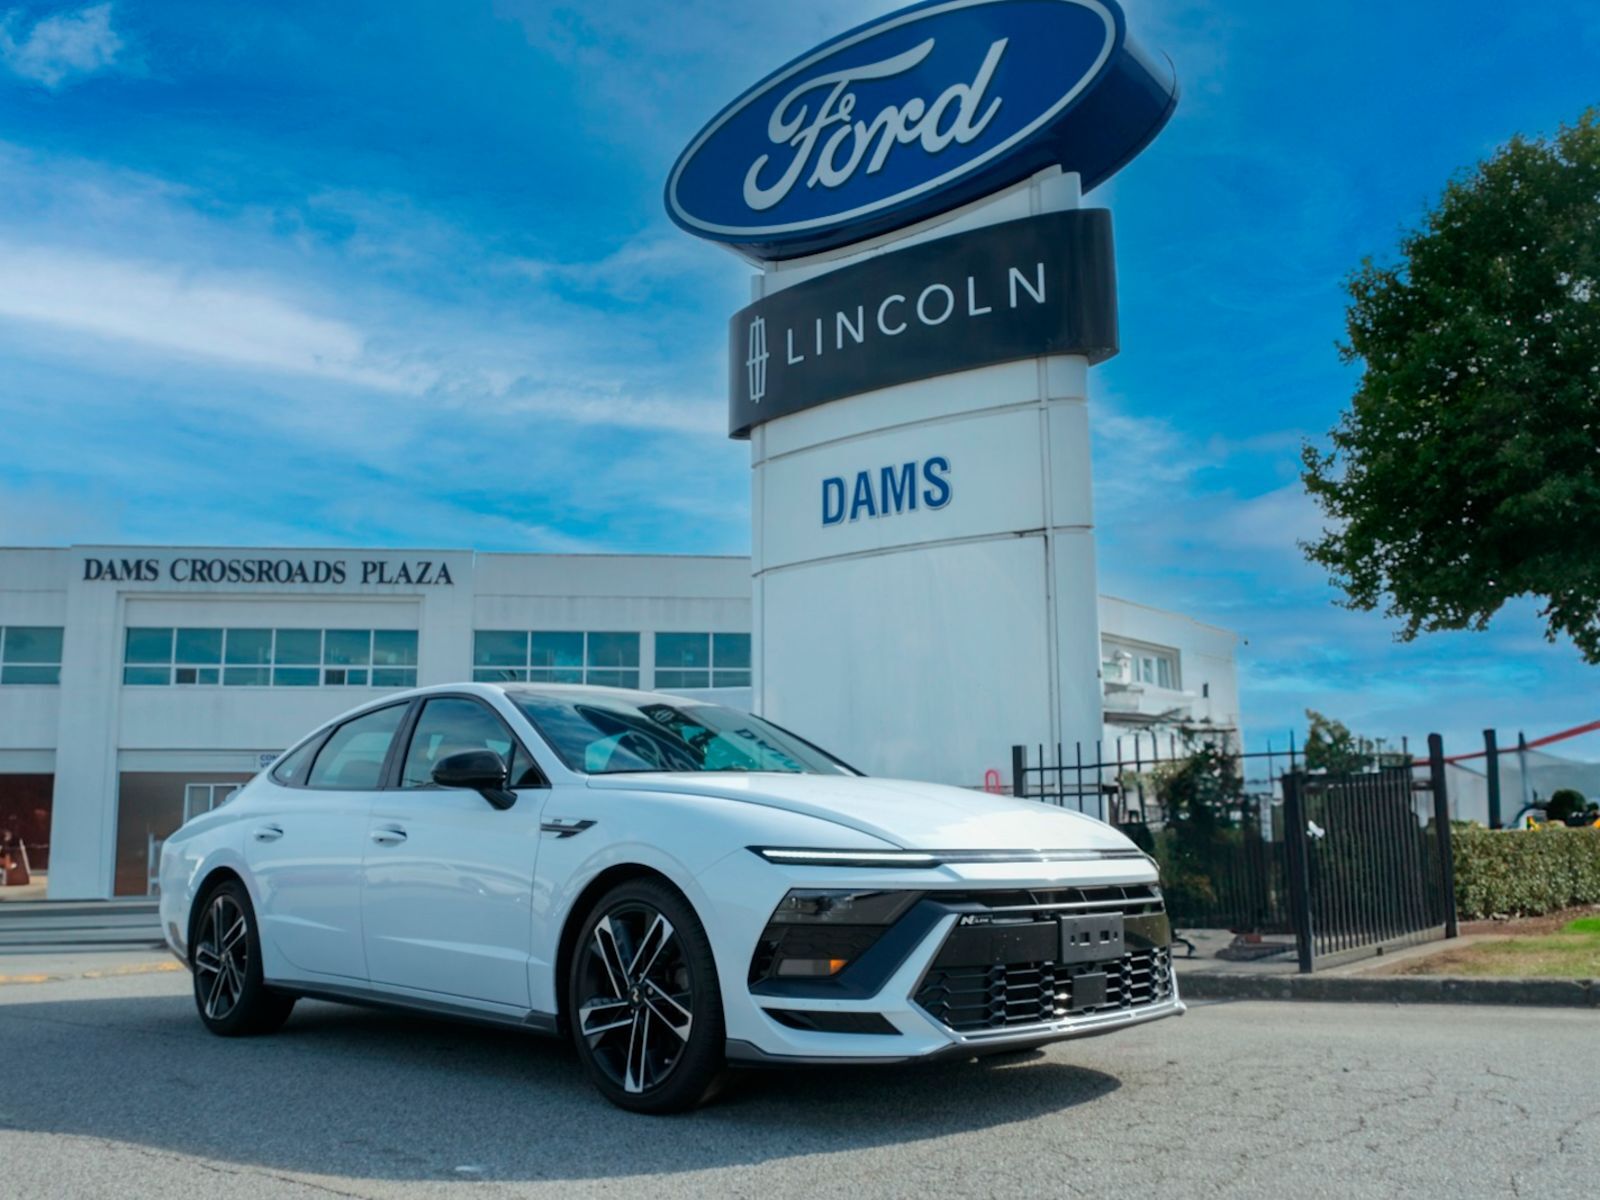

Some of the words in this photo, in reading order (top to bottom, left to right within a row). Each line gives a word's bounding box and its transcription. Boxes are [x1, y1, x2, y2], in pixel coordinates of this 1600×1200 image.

[743, 37, 1009, 210] Ford
[787, 262, 1046, 365] LINCOLN
[822, 456, 951, 526] DAMS
[83, 558, 159, 581] DAMS
[170, 558, 346, 584] CROSSROADS
[360, 561, 454, 585] PLAZA
